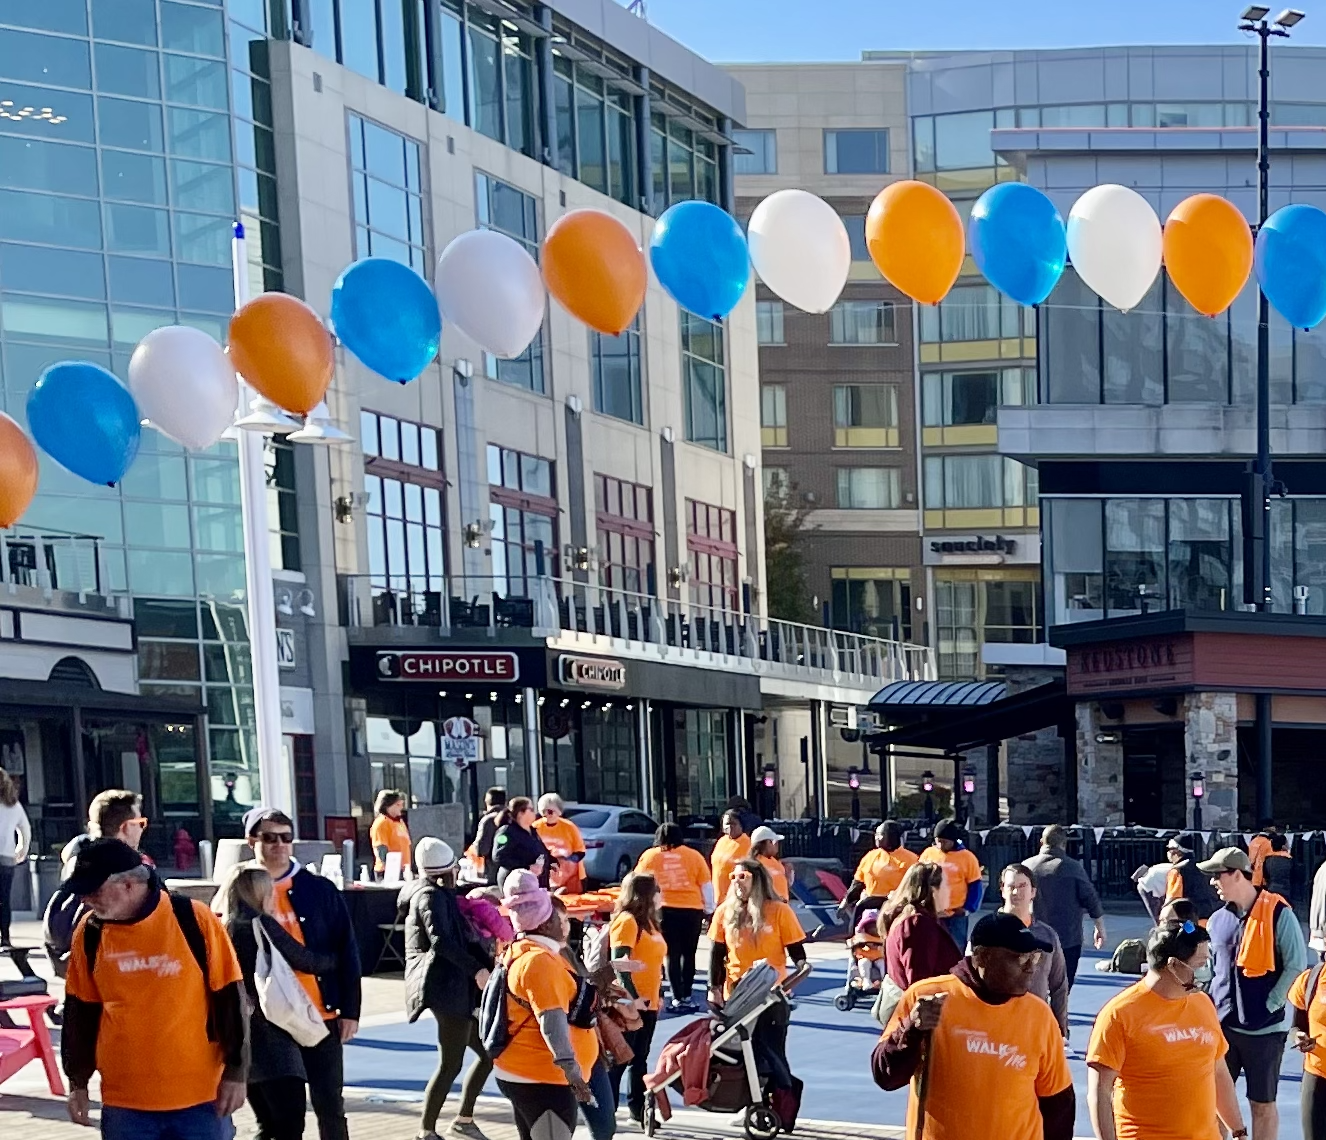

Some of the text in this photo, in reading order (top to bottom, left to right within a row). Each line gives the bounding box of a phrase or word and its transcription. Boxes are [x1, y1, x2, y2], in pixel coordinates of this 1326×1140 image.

[404, 658, 507, 675] CHIPOTLE
[582, 664, 626, 684] CHIPOTLE
[966, 1039, 1008, 1058] WALK
